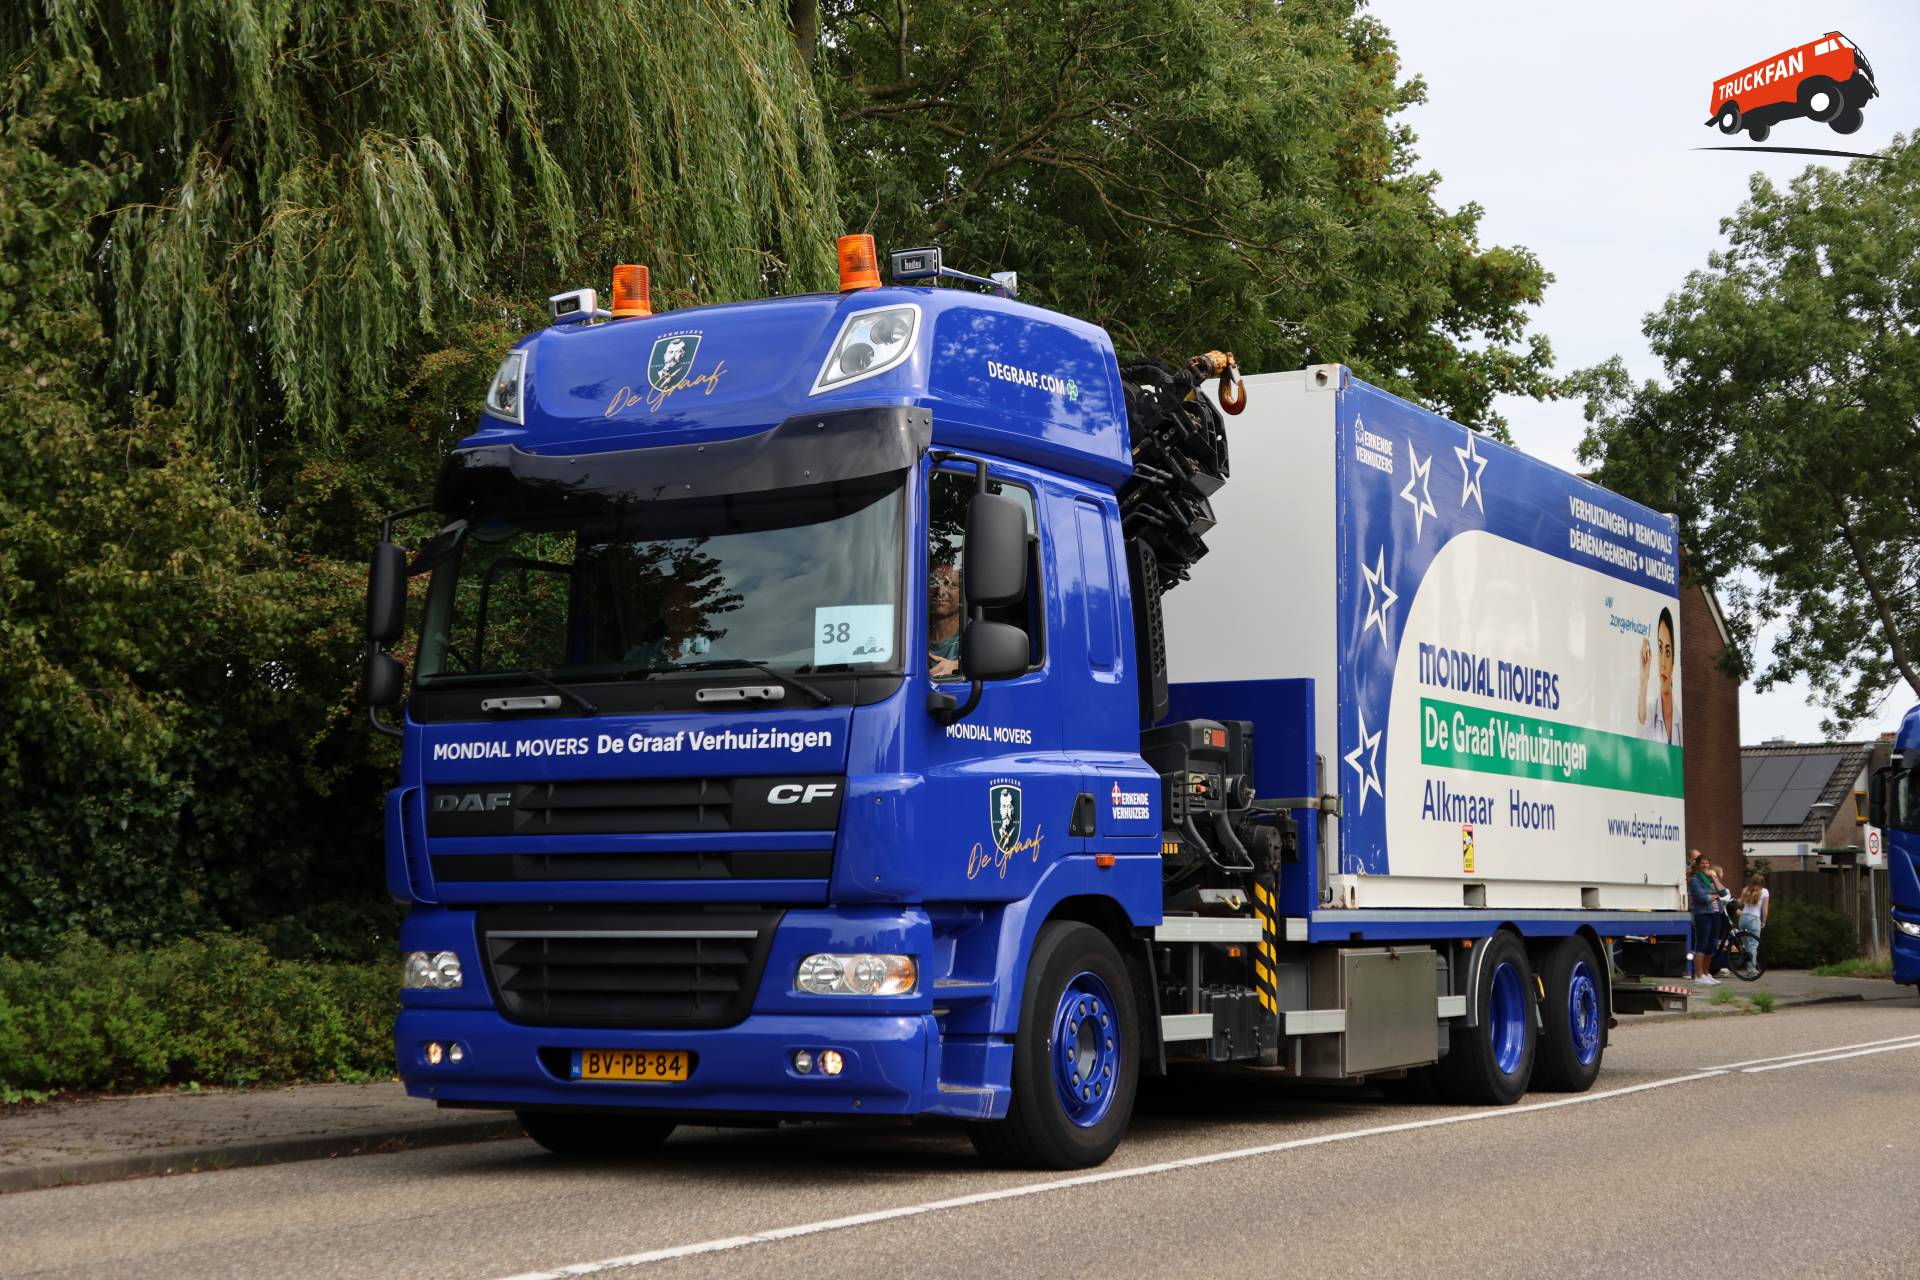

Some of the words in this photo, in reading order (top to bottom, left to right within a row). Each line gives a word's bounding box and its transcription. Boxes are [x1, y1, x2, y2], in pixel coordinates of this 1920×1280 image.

[605, 386, 642, 417] De
[646, 360, 728, 413] Graaf
[987, 360, 1066, 396] DEGRAAF.COM
[1364, 430, 1393, 457] ERKENDE
[1355, 444, 1393, 475] VERHUIZERS
[1569, 495, 1628, 538] VERHUIZINGEN
[1635, 523, 1673, 556] REMOVALS
[1569, 523, 1638, 572] DÉMÉNAGEMENTS
[1645, 556, 1675, 585] UMZÜGE
[822, 622, 851, 645] 38
[433, 741, 511, 760] MONDIAL
[515, 737, 589, 757] MOVERS
[597, 734, 624, 754] De
[627, 731, 684, 753] Graaf
[689, 727, 832, 753] Verhuizingen
[946, 722, 991, 742] MONDIAL
[993, 727, 1032, 745] MOVERS
[1425, 706, 1449, 750] De
[1452, 710, 1495, 757] Graaf
[1496, 719, 1587, 777] Verhuizingen
[432, 792, 511, 812] DAF
[767, 784, 837, 805] CF
[1121, 793, 1149, 805] ERKENDE
[1422, 779, 1494, 825] Alkmaar
[1509, 789, 1555, 830] Hoorn
[1112, 806, 1150, 820] VERHUIZERS
[1607, 812, 1680, 845] www.degraaf.com
[967, 842, 992, 880] De
[995, 824, 1044, 880] Graaf
[1871, 839, 1878, 849] 30
[589, 1053, 682, 1077] BV-PB-84
